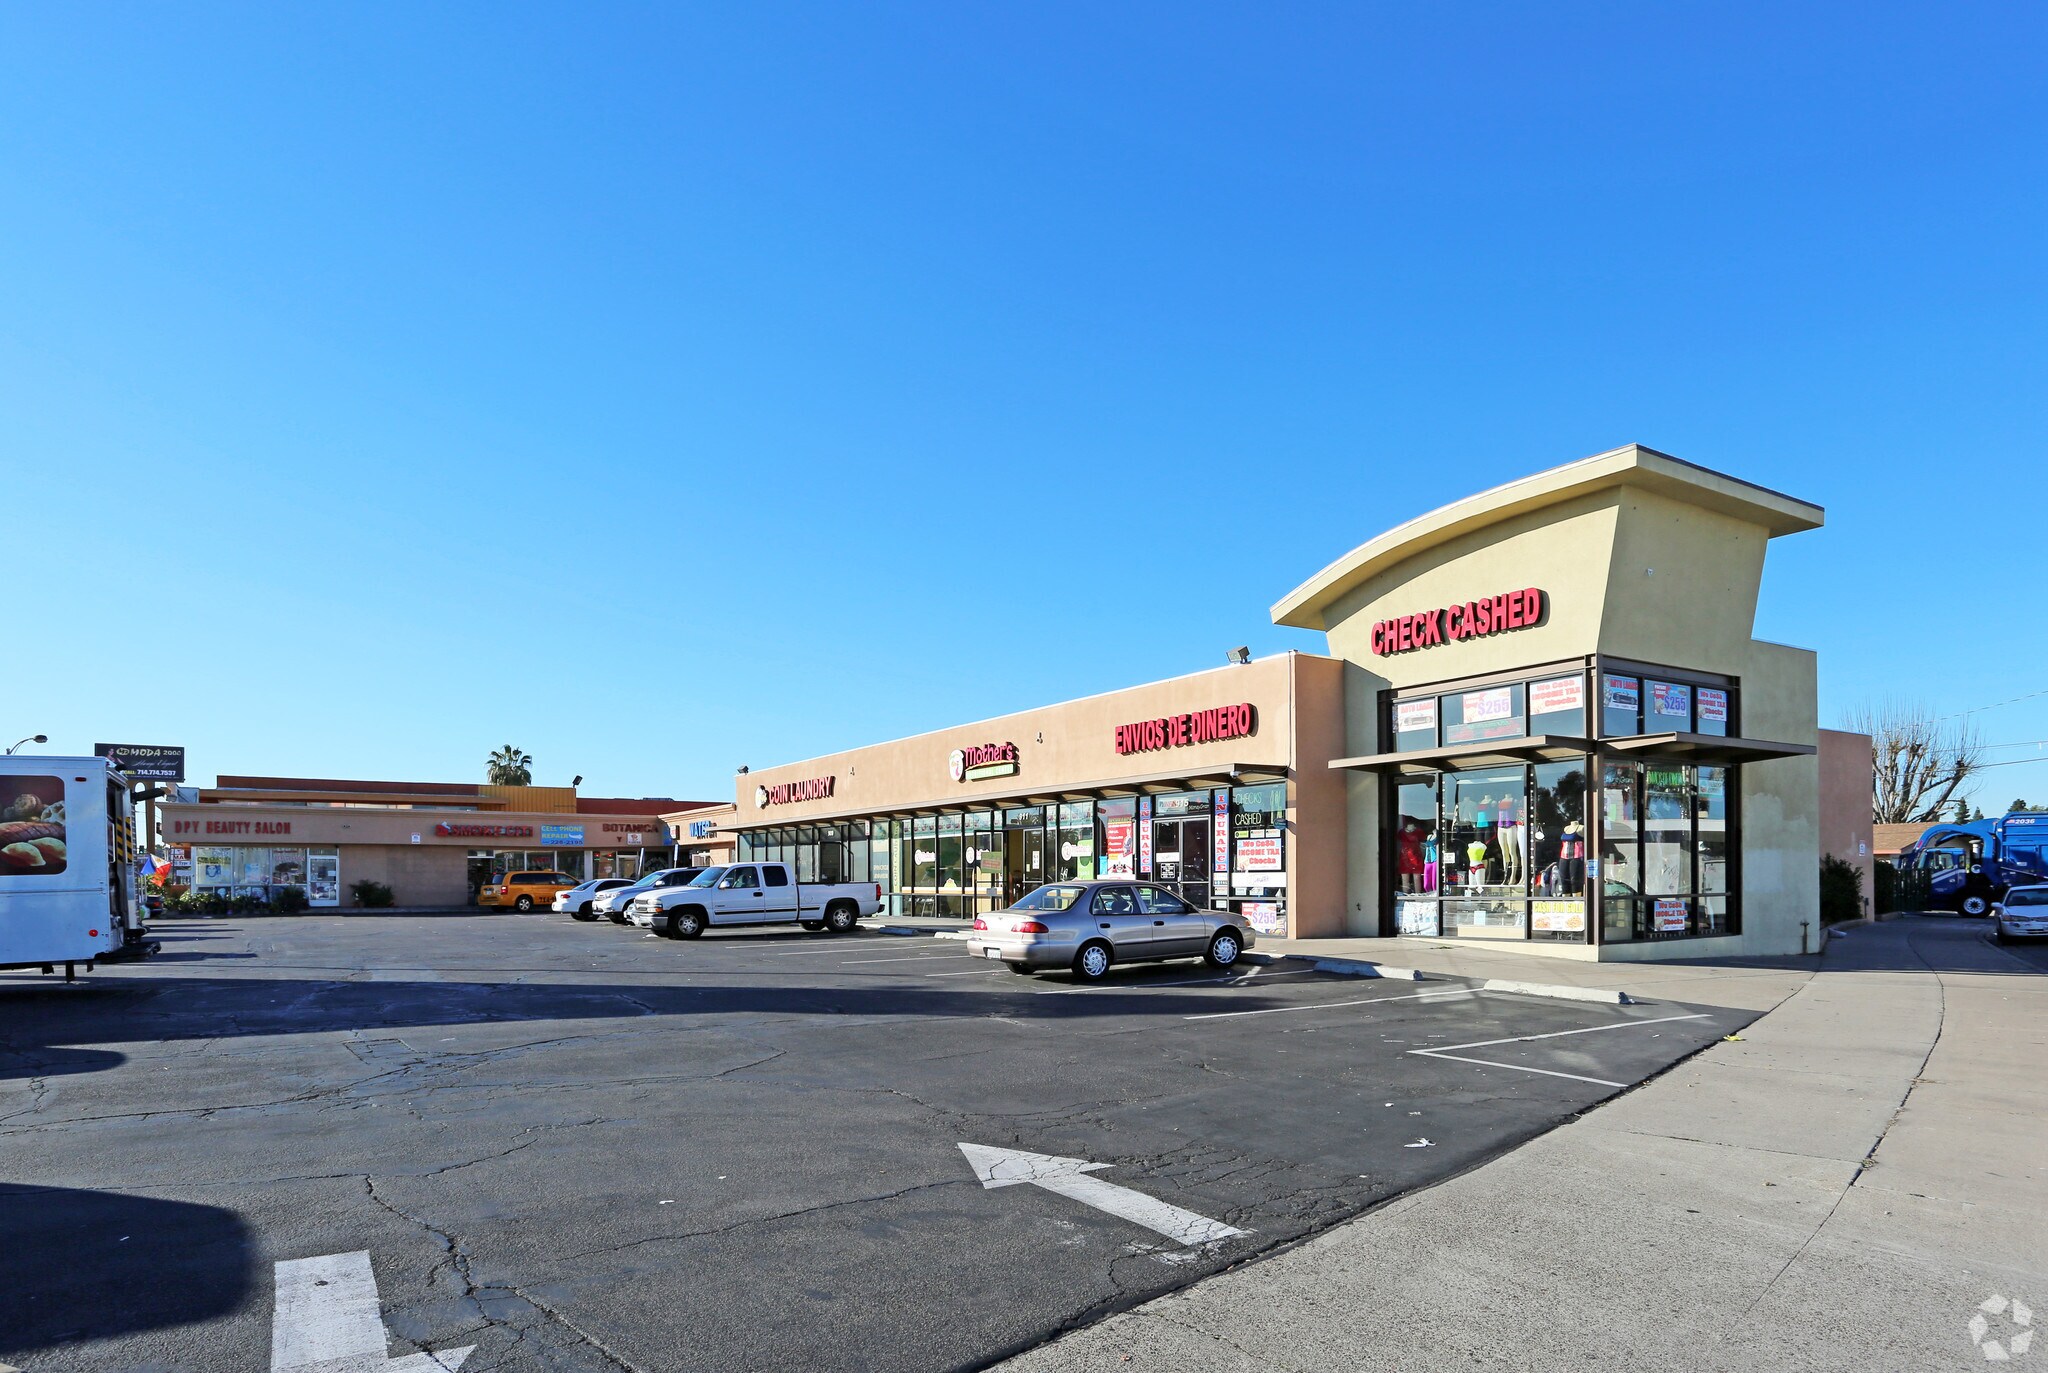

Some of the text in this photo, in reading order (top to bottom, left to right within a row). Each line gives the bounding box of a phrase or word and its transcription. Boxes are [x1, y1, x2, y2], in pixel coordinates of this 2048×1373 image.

[1371, 587, 1541, 655] CHECK CASHED
[1478, 698, 1510, 717] $255
[1665, 695, 1686, 711] $255
[1115, 702, 1251, 754] ENVIOS DE DINERO
[130, 748, 161, 757] MODA
[965, 743, 1013, 767] Mother's
[769, 776, 832, 804] COIN LAUNDRY
[1236, 791, 1262, 806] CHECKS
[1235, 813, 1262, 826] CASHED
[206, 821, 251, 835] BEAUTY
[254, 822, 292, 835] SALON
[451, 824, 534, 838] SMOKE CITI
[602, 823, 659, 834] BOTANICA
[1216, 795, 1226, 870] INSURANCE
[1141, 802, 1150, 872] INSURANCE
[1252, 911, 1276, 925] $255
